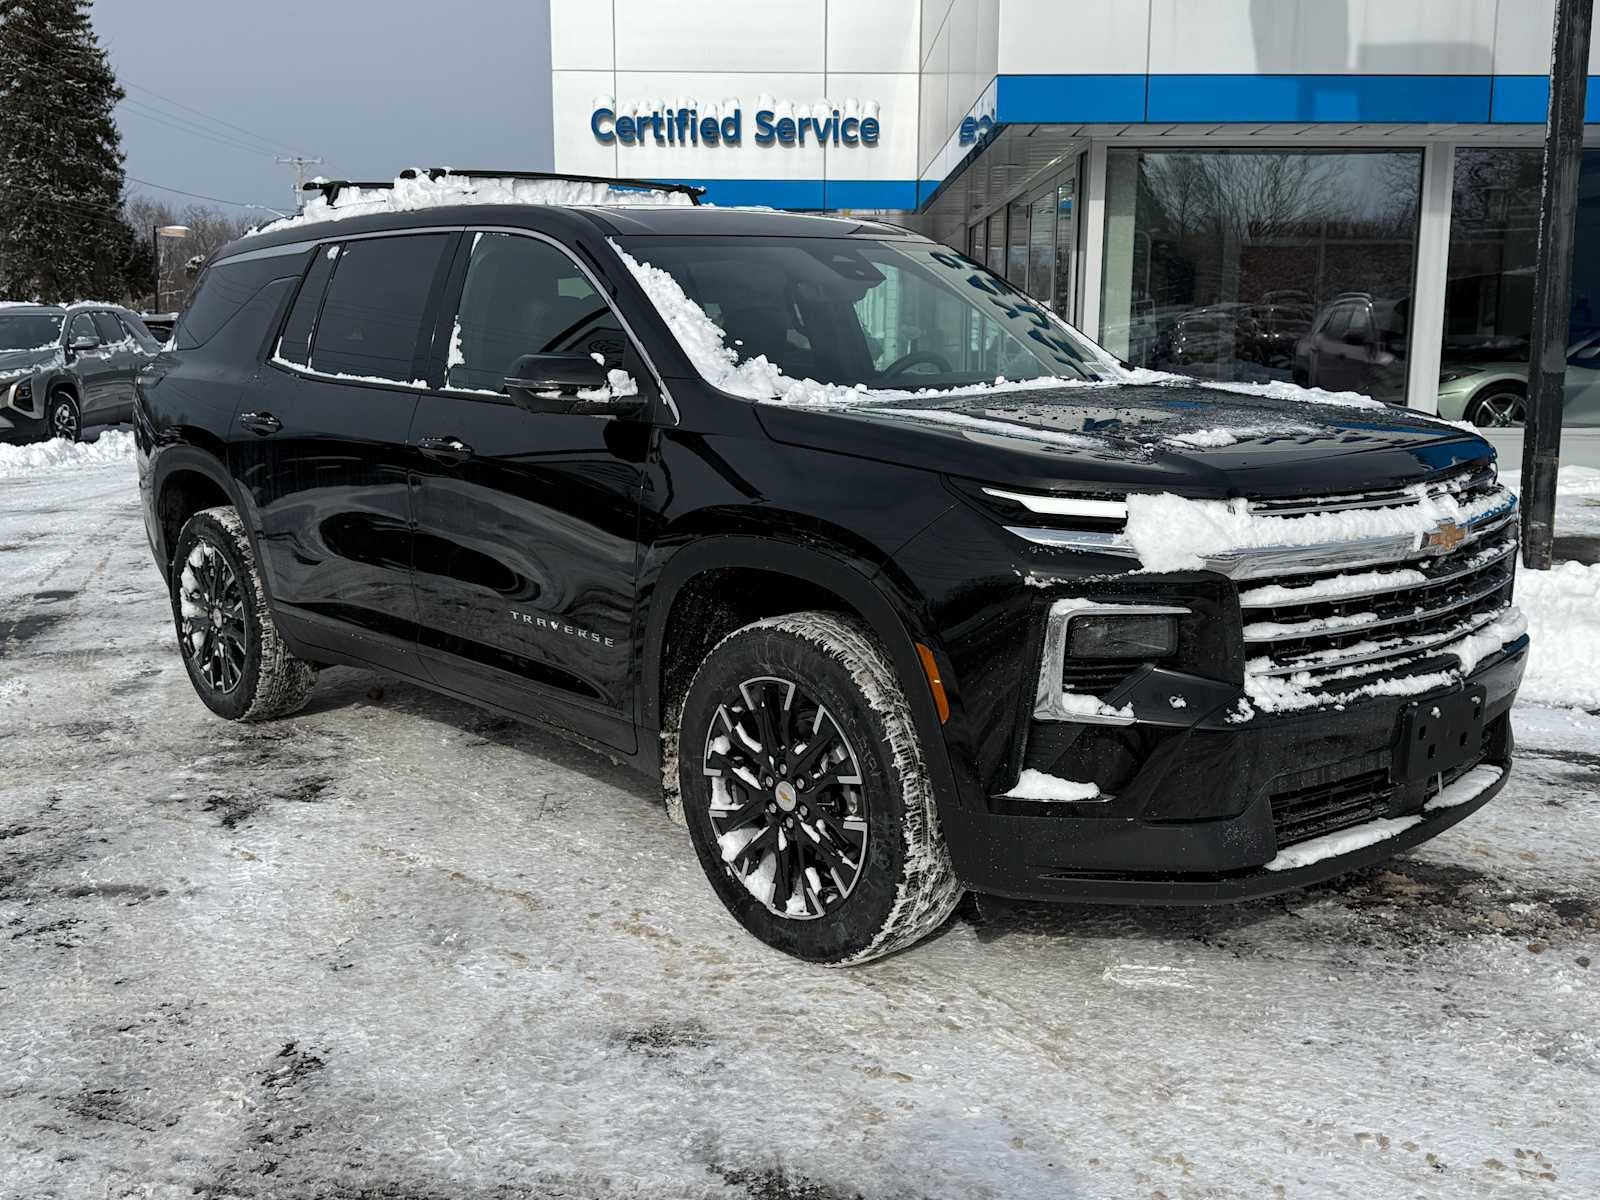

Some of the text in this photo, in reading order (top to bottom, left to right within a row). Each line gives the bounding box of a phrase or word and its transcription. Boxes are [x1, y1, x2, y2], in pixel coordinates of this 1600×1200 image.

[591, 107, 880, 145] Certified Service
[510, 610, 614, 648] TRAVERSE
